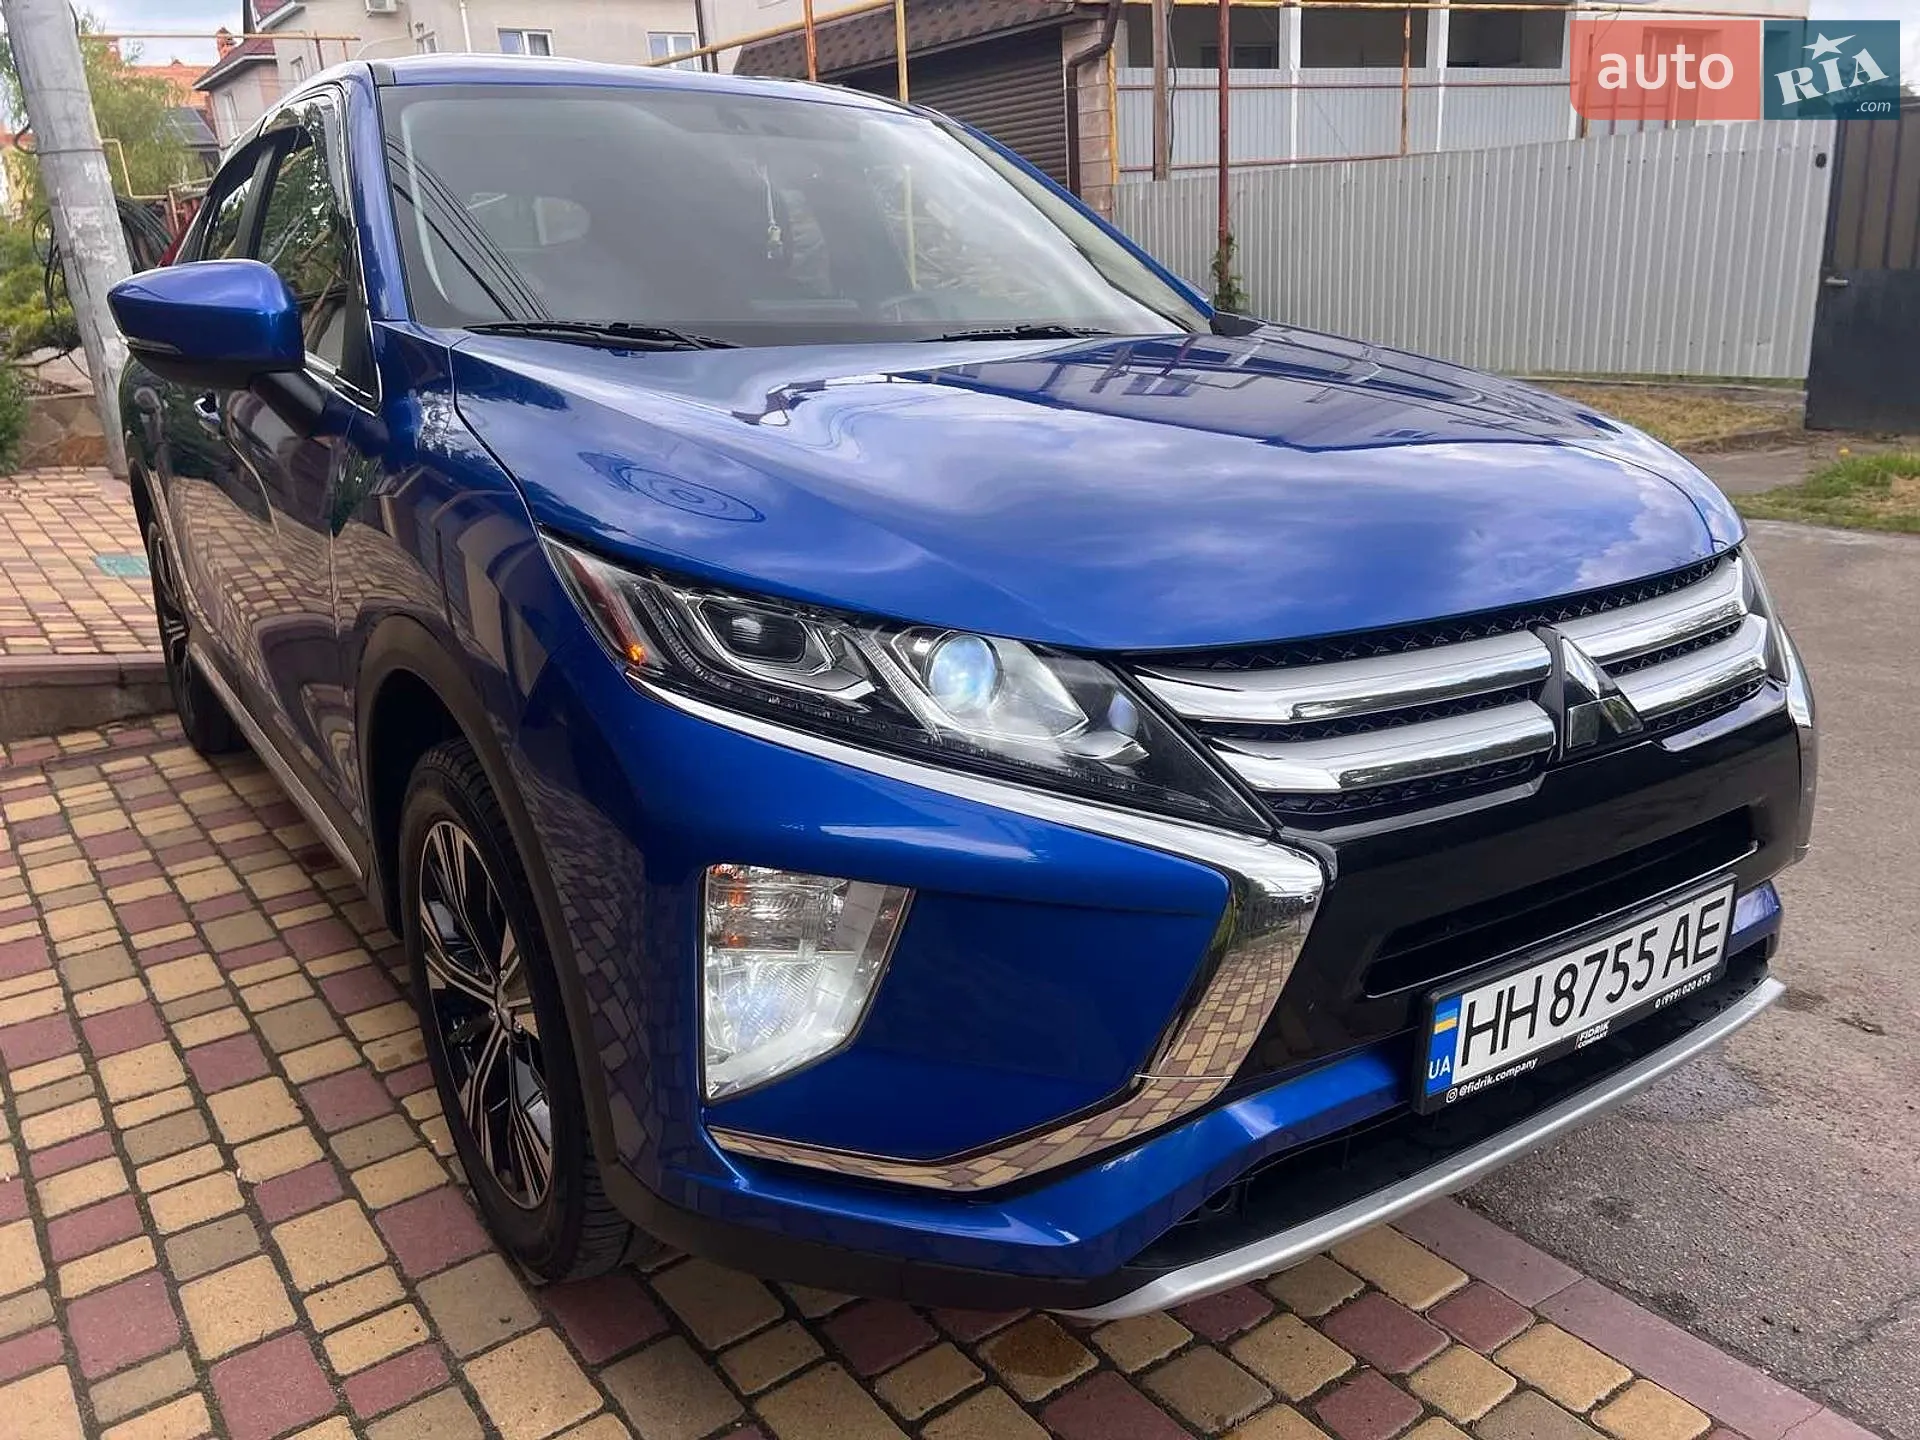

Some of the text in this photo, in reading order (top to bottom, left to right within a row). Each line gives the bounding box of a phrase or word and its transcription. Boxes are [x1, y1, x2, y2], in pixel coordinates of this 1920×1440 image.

[1579, 1020, 1610, 1042] FIDRIK
[1428, 1055, 1451, 1080] UA
[1459, 1057, 1539, 1096] @fidrik.company
